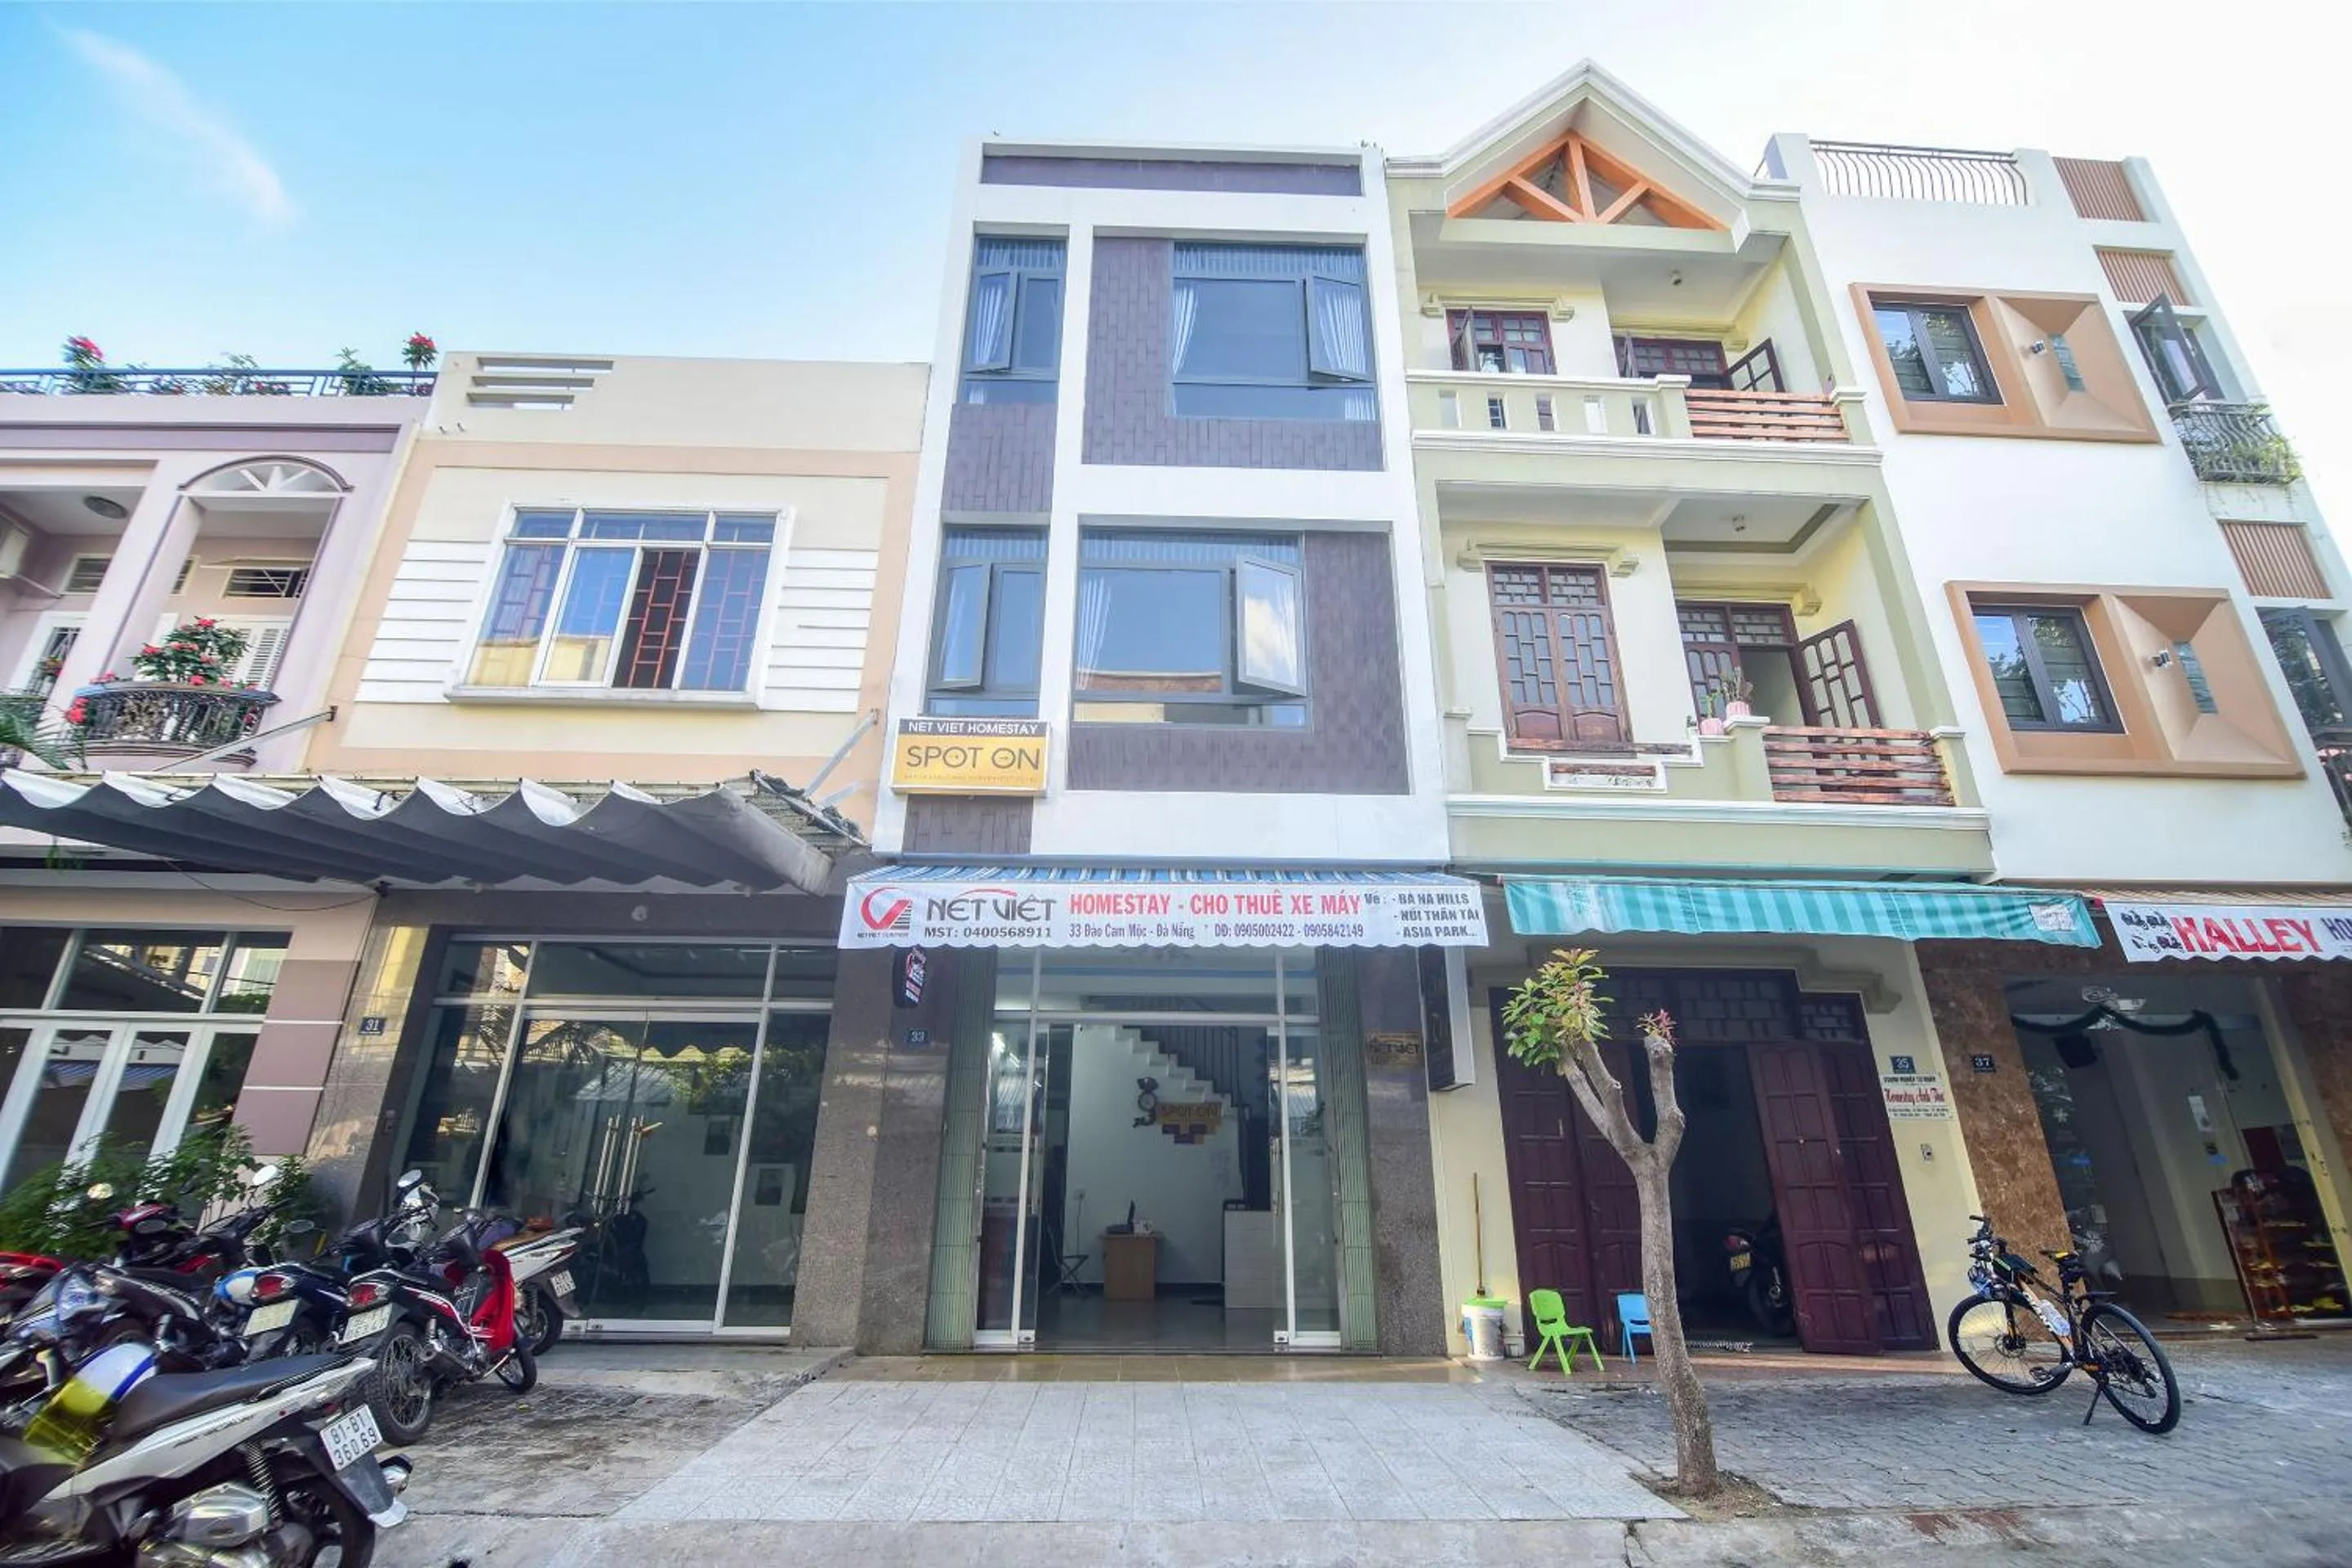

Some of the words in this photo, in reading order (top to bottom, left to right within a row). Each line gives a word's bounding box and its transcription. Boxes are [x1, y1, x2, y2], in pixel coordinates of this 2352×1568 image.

[908, 721, 933, 733] NET
[936, 721, 964, 733] VIET
[967, 722, 1039, 735] HOMESTAY
[906, 745, 983, 768] SPOT
[991, 746, 1040, 770] ON
[1070, 893, 1171, 915] HOMESTAY
[1190, 893, 1228, 915] CHO
[1234, 889, 1283, 915] THUÊ
[1290, 894, 1314, 915] XE
[1321, 889, 1361, 915] MÁY
[1437, 893, 1470, 905] HILLS
[926, 898, 987, 922] NET
[924, 926, 959, 938] MST:
[963, 927, 1053, 938] 0400568911
[1069, 923, 1081, 938] 33
[1403, 925, 1433, 938] ASIA
[2169, 916, 2323, 952] HALLEY
[2320, 917, 2352, 941] HO
[1975, 1058, 1990, 1067] 37
